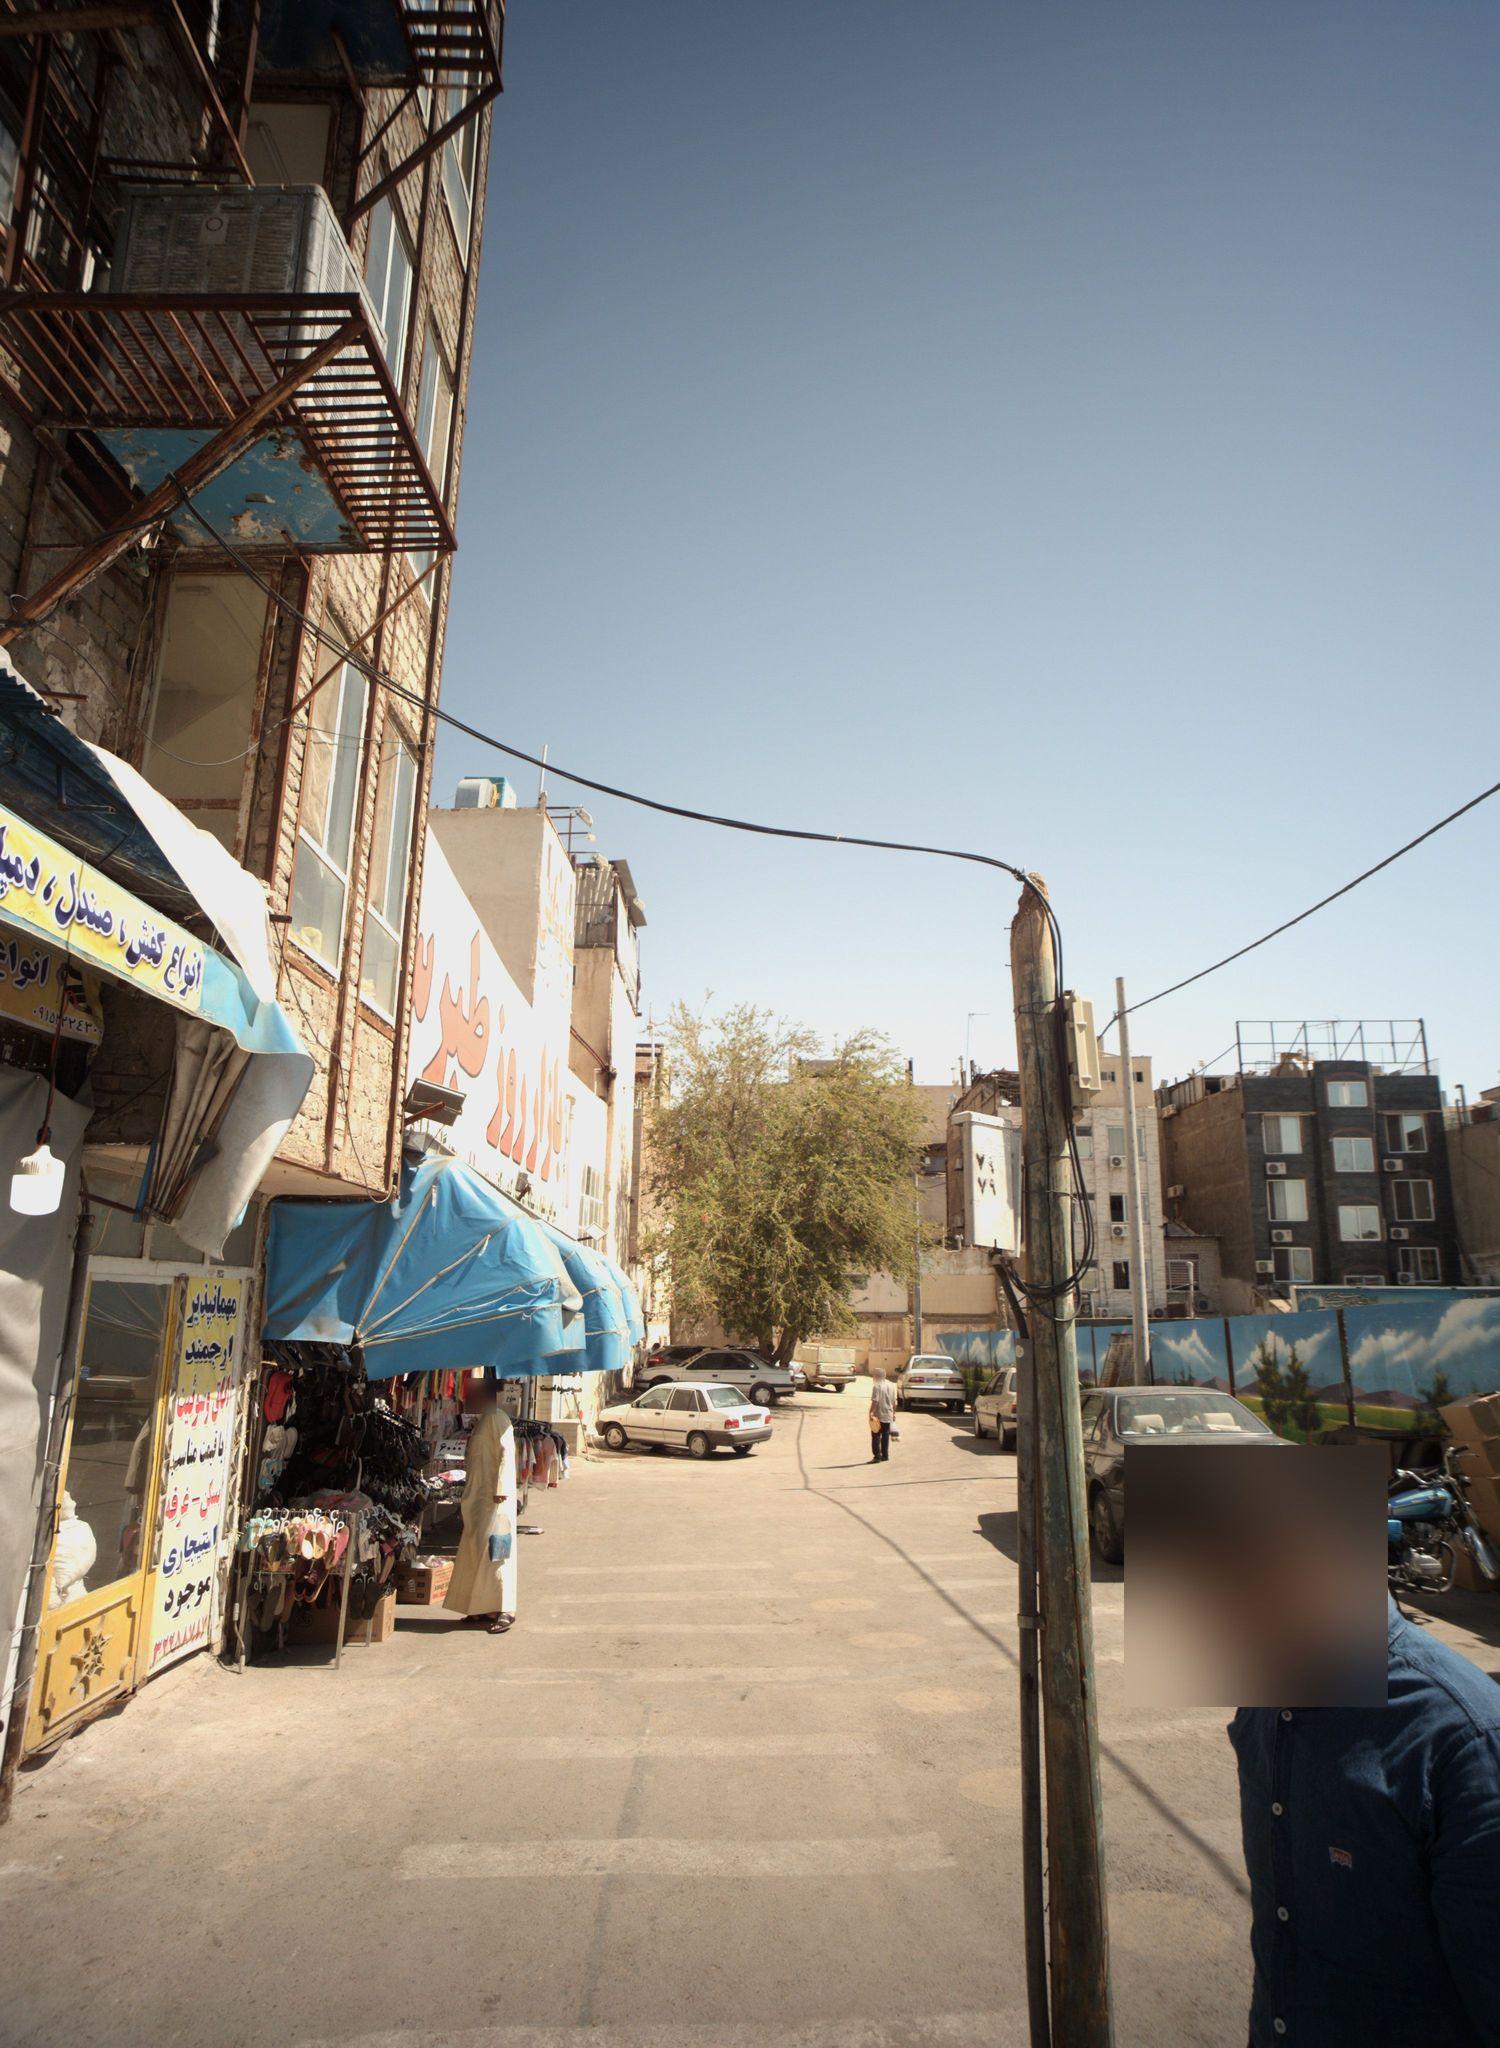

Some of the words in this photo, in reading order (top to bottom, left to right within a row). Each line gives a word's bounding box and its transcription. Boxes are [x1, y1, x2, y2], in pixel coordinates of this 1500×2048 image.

[164, 944, 202, 997] انواع
[185, 1334, 235, 1368] ارجمند
[164, 1575, 211, 1619] موجود
